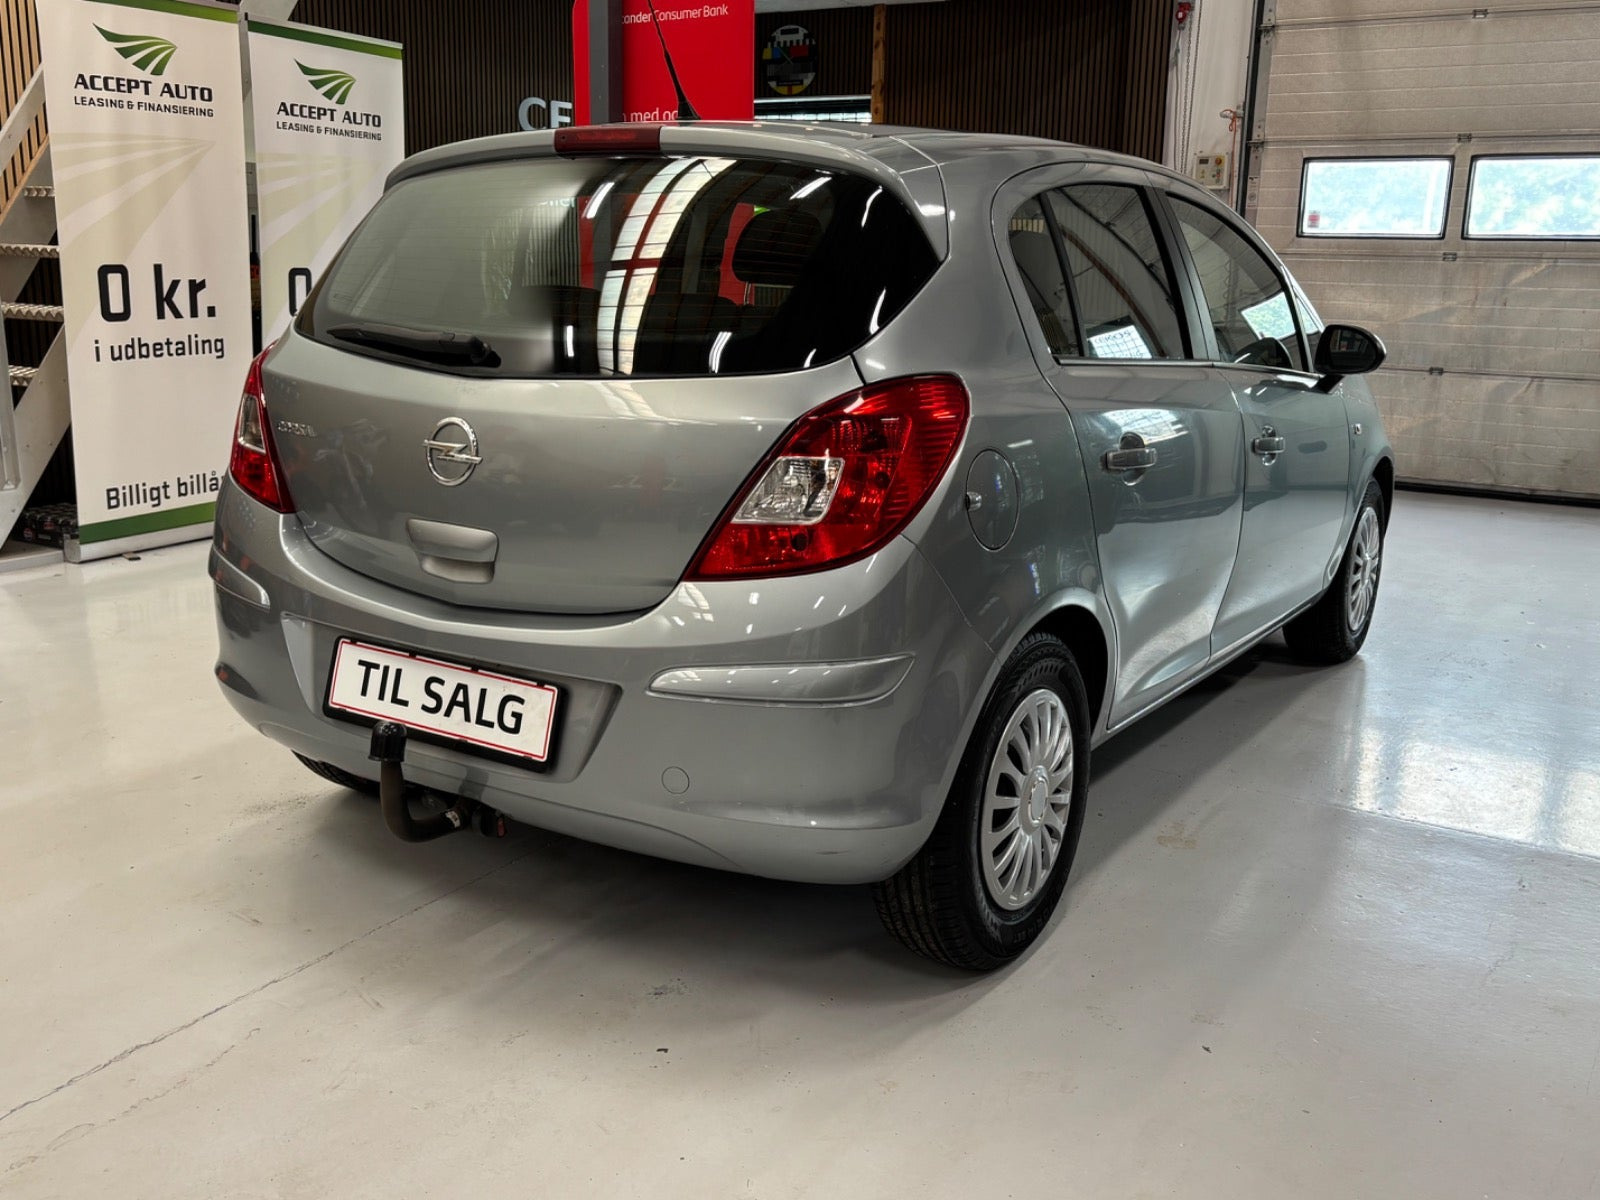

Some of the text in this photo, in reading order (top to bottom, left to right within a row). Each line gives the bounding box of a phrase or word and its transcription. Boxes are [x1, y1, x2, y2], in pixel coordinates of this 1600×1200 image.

[622, 4, 729, 25] ander Consumer Bank
[74, 73, 213, 102] ACCEPT AUTO
[74, 96, 214, 118] LEASING & FINANSIERING
[276, 101, 382, 128] ACCEPT AUTO
[631, 107, 660, 122] med
[276, 121, 382, 141] LEASING & FINANSIERING
[97, 263, 216, 322] 0 kr.
[94, 333, 225, 362] i udbetaling
[106, 470, 226, 510] Billigt billå
[357, 659, 526, 735] TIL SALG
